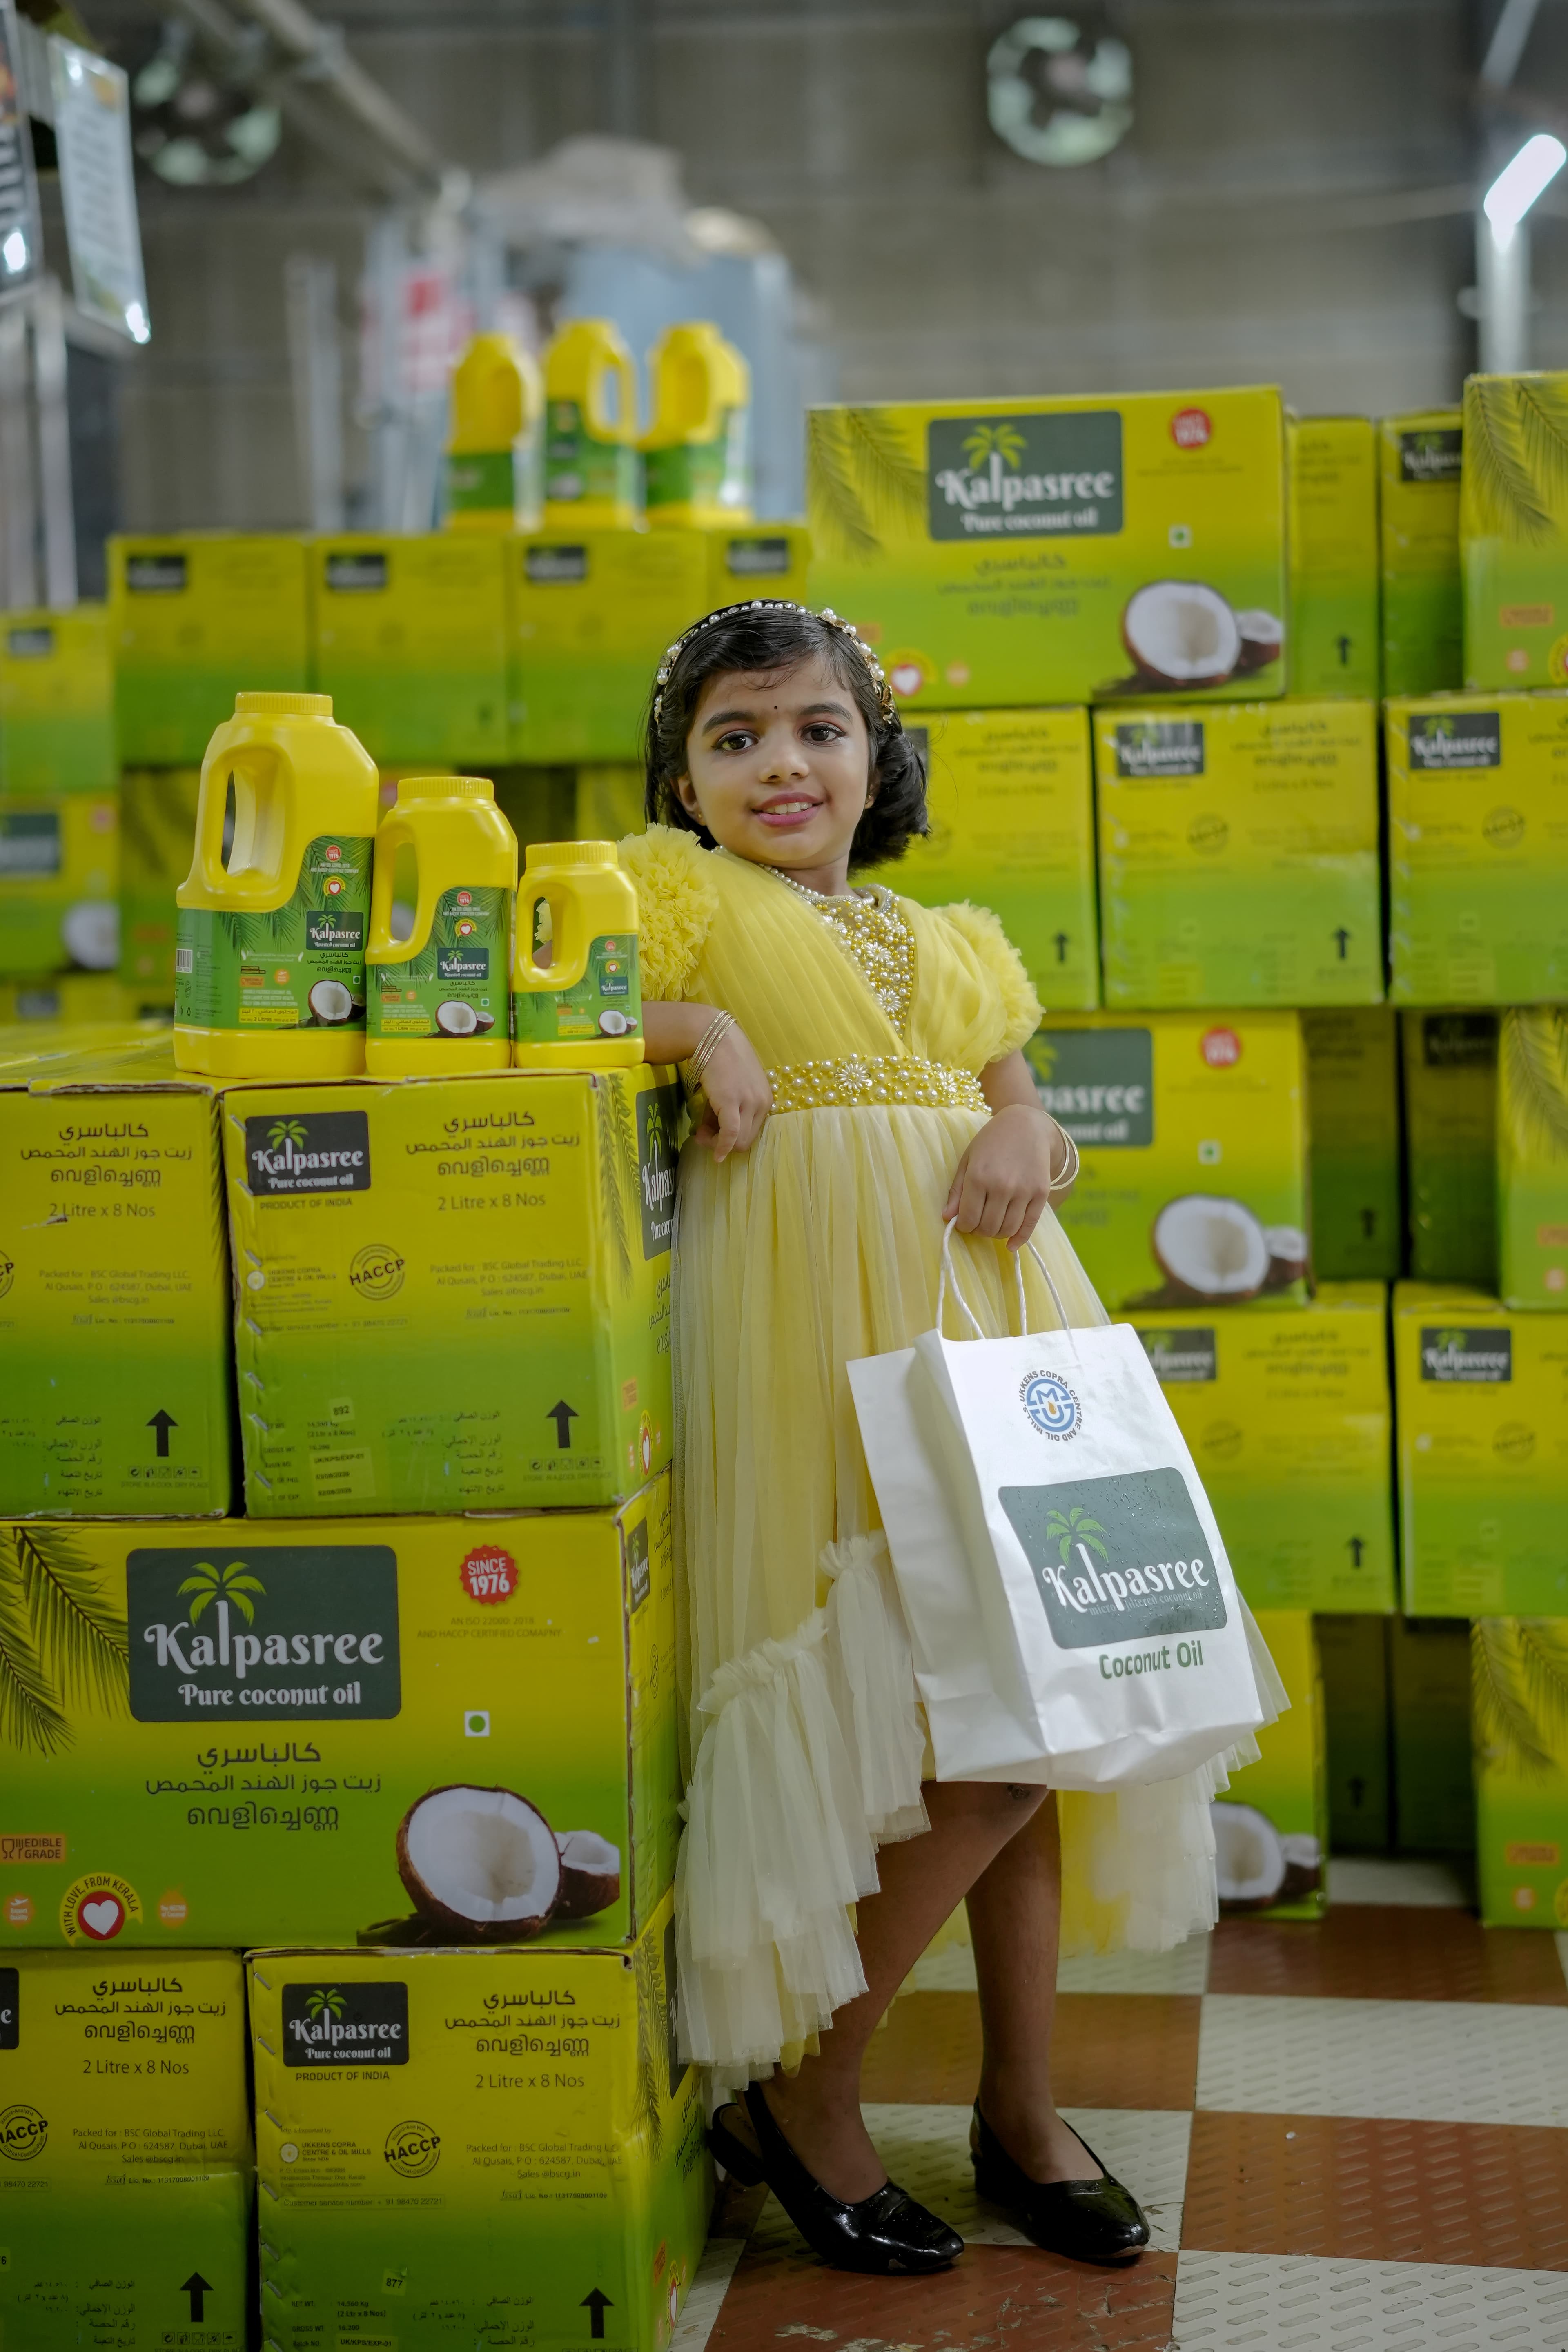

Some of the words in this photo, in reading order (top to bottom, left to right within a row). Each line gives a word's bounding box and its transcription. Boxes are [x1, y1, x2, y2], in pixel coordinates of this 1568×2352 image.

[935, 451, 1114, 511] Kalpasree
[960, 511, 1002, 532] Pure
[1004, 510, 1074, 532] coconut
[1075, 506, 1097, 528] oil
[309, 923, 361, 942] Kalpasree
[440, 957, 486, 972] Kalpasree
[443, 1111, 535, 1138] كالباسري
[59, 1123, 149, 1146] كالباسري
[20, 1146, 85, 1160] المحمص
[90, 1146, 130, 1158] الهند
[134, 1147, 160, 1160] جوز
[164, 1145, 192, 1160] زيت
[405, 1138, 471, 1155] المحمص
[251, 1137, 365, 1176] Kalpasree
[437, 1155, 550, 1178] വെളിച്ചെണ്ണ
[51, 1165, 161, 1188] വെളിച്ചെണ്ണ
[267, 1177, 294, 1189] Pure
[296, 1175, 337, 1188] coconut
[339, 1173, 354, 1186] oil
[49, 1203, 57, 1217] 2
[63, 1203, 96, 1217] Litre
[101, 1206, 109, 1216] x
[113, 1203, 122, 1217] 8
[127, 1203, 157, 1217] Nos
[259, 1200, 307, 1211] PRODUCT
[310, 1199, 322, 1209] OF
[326, 1198, 353, 1207] INDIA
[437, 1196, 446, 1211] 2
[451, 1195, 485, 1210] Litre
[490, 1198, 498, 1208] x
[502, 1194, 511, 1208] 8
[516, 1192, 546, 1207] Nos
[350, 1258, 405, 1286] HACCP
[1019, 1370, 1038, 1402] UKKENS
[1040, 1370, 1068, 1389] COPRA
[333, 1405, 350, 1416] 892
[1069, 1389, 1082, 1430] CENTRE
[1045, 1431, 1060, 1442] OIL
[1062, 1428, 1077, 1441] AND
[467, 1557, 507, 1576] SINCE
[469, 1573, 510, 1597] 1976
[1042, 1543, 1209, 1613] Kalpasree
[1087, 1604, 1116, 1617] micro
[1124, 1593, 1158, 1613] filtered
[1159, 1590, 1192, 1604] coconut
[143, 1600, 385, 1679] Kalpasree
[1098, 1645, 1171, 1679] Coconut
[1176, 1639, 1203, 1668] Oil
[178, 1683, 234, 1706] Pure
[239, 1684, 328, 1706] coconut
[332, 1681, 361, 1704] oil
[196, 1742, 321, 1775] كالباسري
[145, 1775, 234, 1795] المحمص
[241, 1774, 294, 1791] الهند
[301, 1775, 338, 1794] جوز
[343, 1773, 382, 1793] زيت
[187, 1801, 339, 1831] വെളിച്ചെണ്ണ
[24, 1838, 62, 1847] EDIBLE
[24, 1849, 61, 1859] GRADE
[84, 1875, 111, 1889] FROM
[67, 1886, 85, 1909] LOVE,
[111, 1880, 139, 1913] KERALA
[63, 1911, 76, 1937] WITH
[92, 1977, 183, 2000] كالباسري
[54, 2001, 119, 2016] المحمص
[123, 2001, 163, 2013] الهند
[168, 2002, 194, 2017] جوز
[198, 2001, 226, 2016] زيت
[483, 1989, 576, 2015] كالباسري
[288, 2007, 401, 2047] Kalpasree
[445, 2014, 511, 2029] المحمص
[515, 2013, 556, 2026] الهند
[561, 2014, 588, 2029] جوز
[591, 2013, 621, 2029] زيت
[84, 2020, 196, 2044] വെളിച്ചെണ്ണ
[304, 2046, 332, 2060] Pure
[333, 2045, 376, 2060] coconut
[377, 2044, 391, 2059] oil
[476, 2034, 589, 2056] വെളിച്ചെണ്ണ
[82, 2059, 91, 2074] 2
[96, 2059, 130, 2074] Litre
[134, 2063, 143, 2074] x
[147, 2059, 156, 2074] 8
[161, 2059, 190, 2074] Nos
[296, 2072, 343, 2081] PRODUCT
[346, 2072, 359, 2080] OF
[362, 2071, 390, 2080] INDIA
[474, 2074, 484, 2089] 2
[490, 2074, 523, 2088] Litre
[528, 2077, 537, 2087] x
[541, 2074, 550, 2088] 8
[555, 2074, 585, 2088] Nos
[73, 2128, 101, 2137] Packed
[104, 2128, 117, 2137] for
[124, 2128, 141, 2137] BSC
[143, 2128, 171, 2137] Global
[172, 2129, 205, 2139] Trading
[89, 2142, 120, 2152] Qusais,
[210, 2141, 228, 2149] UAE
[383, 2135, 441, 2163] HACCP
[466, 2142, 498, 2152] Packed
[499, 2142, 512, 2152] for
[519, 2142, 536, 2152] BSC
[538, 2142, 567, 2152] Global
[569, 2142, 602, 2153] Trading
[122, 2154, 144, 2163] Sales
[472, 2156, 481, 2165] Al
[517, 2156, 522, 2165] P
[523, 2156, 532, 2165] O
[517, 2169, 540, 2179] Sales
[541, 2168, 581, 2180] @bscg.in
[385, 2278, 404, 2288] 877
